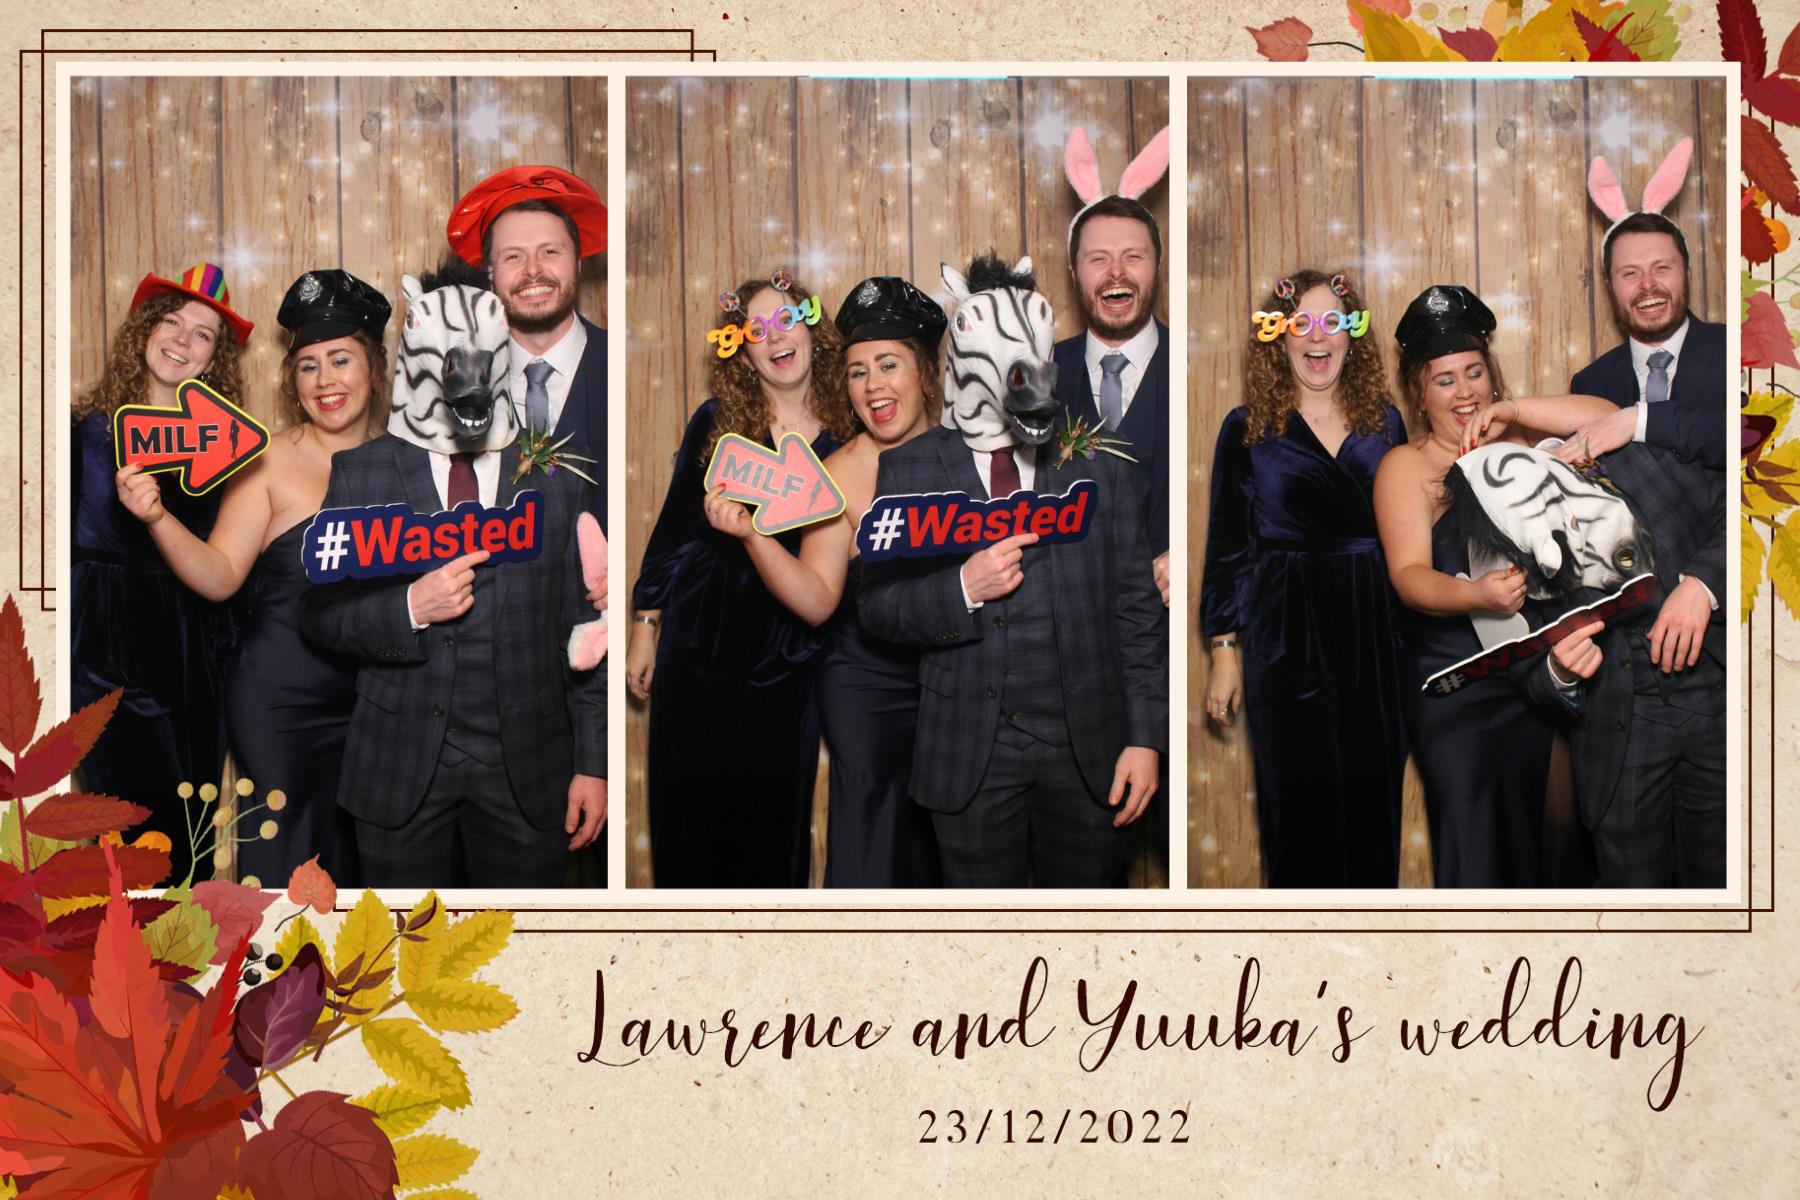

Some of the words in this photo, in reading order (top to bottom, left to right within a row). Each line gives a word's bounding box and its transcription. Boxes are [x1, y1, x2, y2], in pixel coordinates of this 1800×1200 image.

[129, 424, 219, 455] MILF
[720, 453, 805, 501] MILF
[315, 501, 535, 571] #Wasted
[869, 491, 1089, 551] #Wasted
